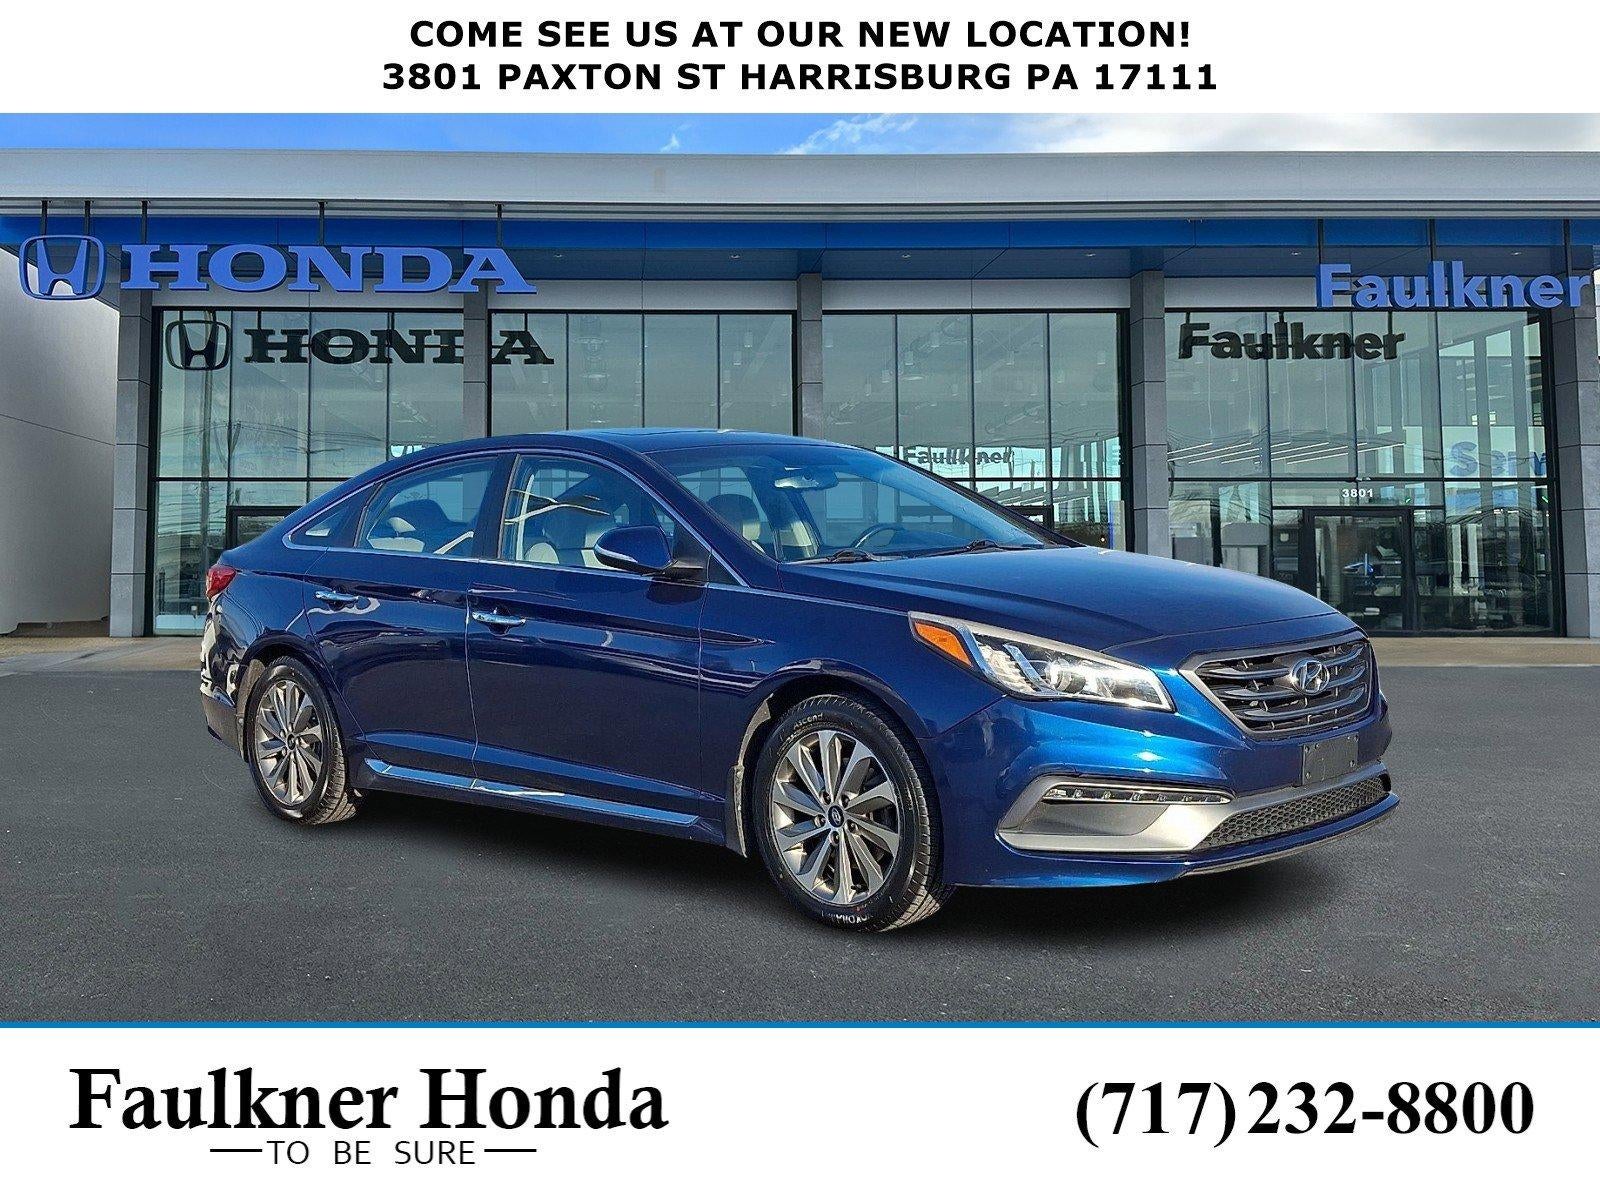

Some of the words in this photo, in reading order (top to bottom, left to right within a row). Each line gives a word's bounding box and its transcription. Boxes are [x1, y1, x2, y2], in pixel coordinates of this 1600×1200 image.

[120, 244, 537, 294] HONDA
[1316, 260, 1591, 309] Faulkner
[1178, 322, 1406, 361] Faulkner
[902, 446, 1014, 465] Faulkner
[1341, 487, 1374, 499] 3801
